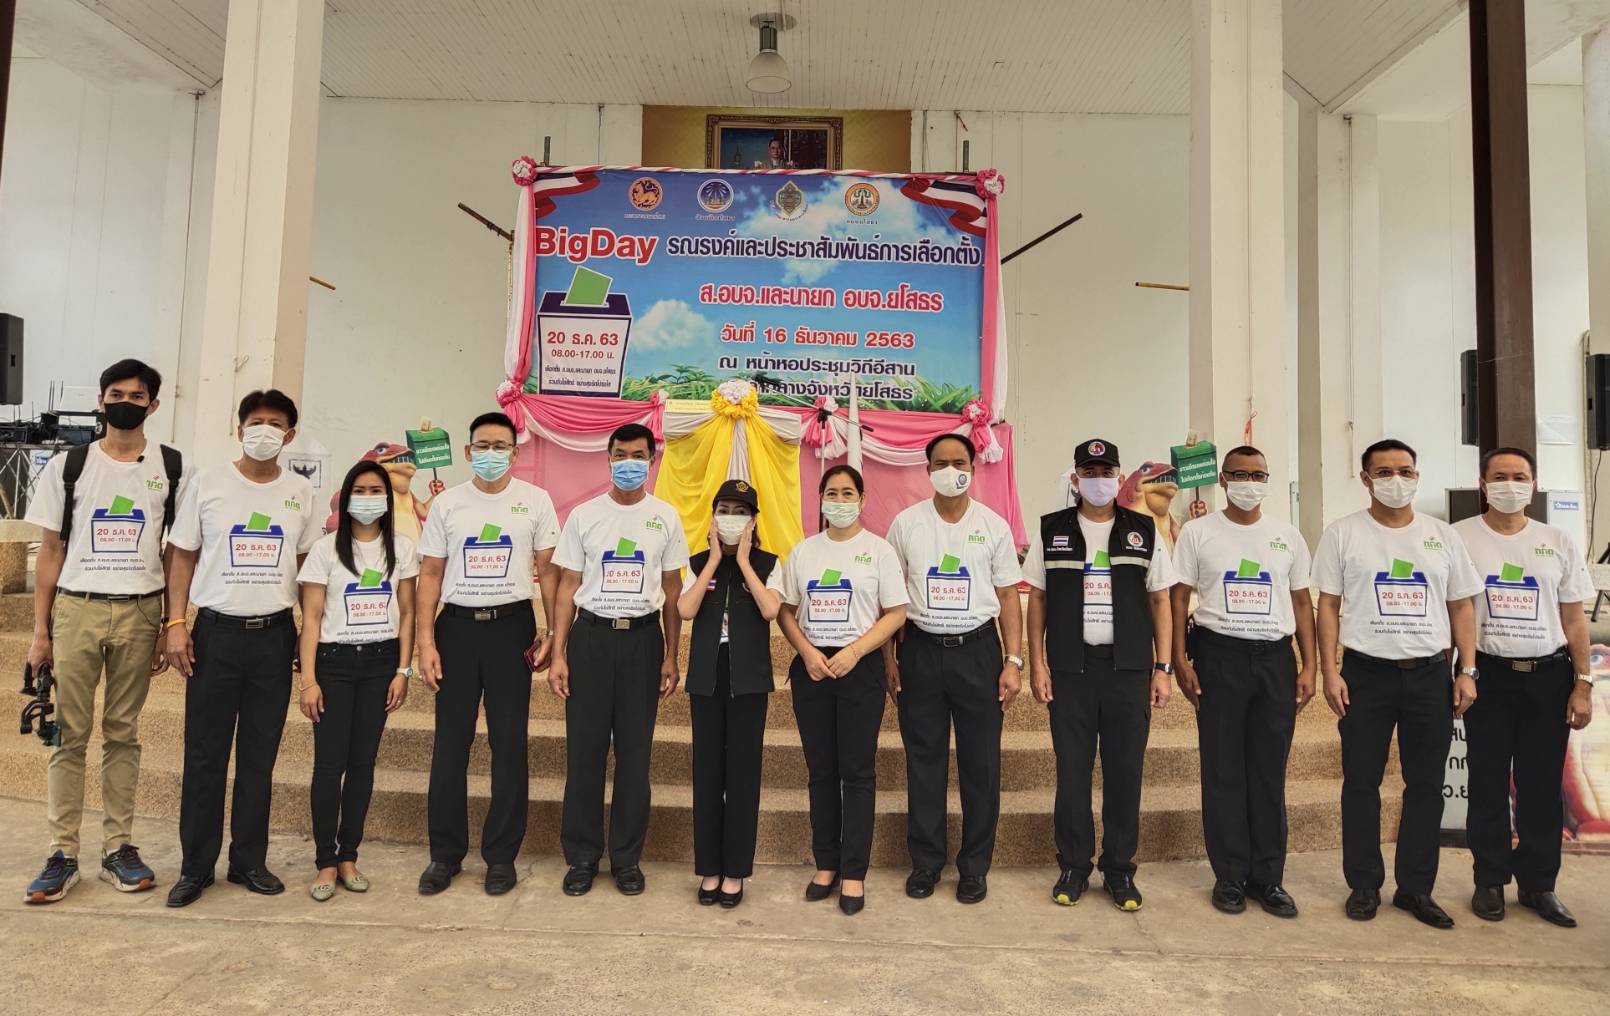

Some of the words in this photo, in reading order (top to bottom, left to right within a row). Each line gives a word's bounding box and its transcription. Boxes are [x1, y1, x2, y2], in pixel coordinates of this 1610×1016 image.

[536, 228, 658, 265] BigDay
[668, 229, 981, 265] รณรงค์และประชาสัมพันธ์การเลือกตั้ง
[700, 284, 835, 308] ส.อบจ.และนายก
[844, 283, 944, 311] อบจ.ยโสธร
[547, 331, 566, 344] 20
[572, 333, 597, 346] ธ.ค.
[600, 333, 619, 346] 63
[721, 322, 755, 342] วันที่
[765, 328, 787, 343] 16
[795, 327, 857, 346] ธันวาคม
[866, 332, 914, 348] 2563
[719, 356, 737, 369] ณ
[746, 352, 915, 376] หน้าหอประชุมวิถีอีสาน
[97, 528, 109, 536] 20
[235, 543, 247, 551] 20
[468, 555, 479, 563] 20
[631, 569, 641, 577] 63
[931, 586, 941, 594] 20
[1229, 590, 1239, 598] 20
[1382, 591, 1394, 599] 20
[1412, 591, 1424, 600] 63
[1491, 594, 1503, 602] 20
[1522, 596, 1534, 604] 63
[838, 598, 847, 606] 63
[351, 603, 361, 611] 20
